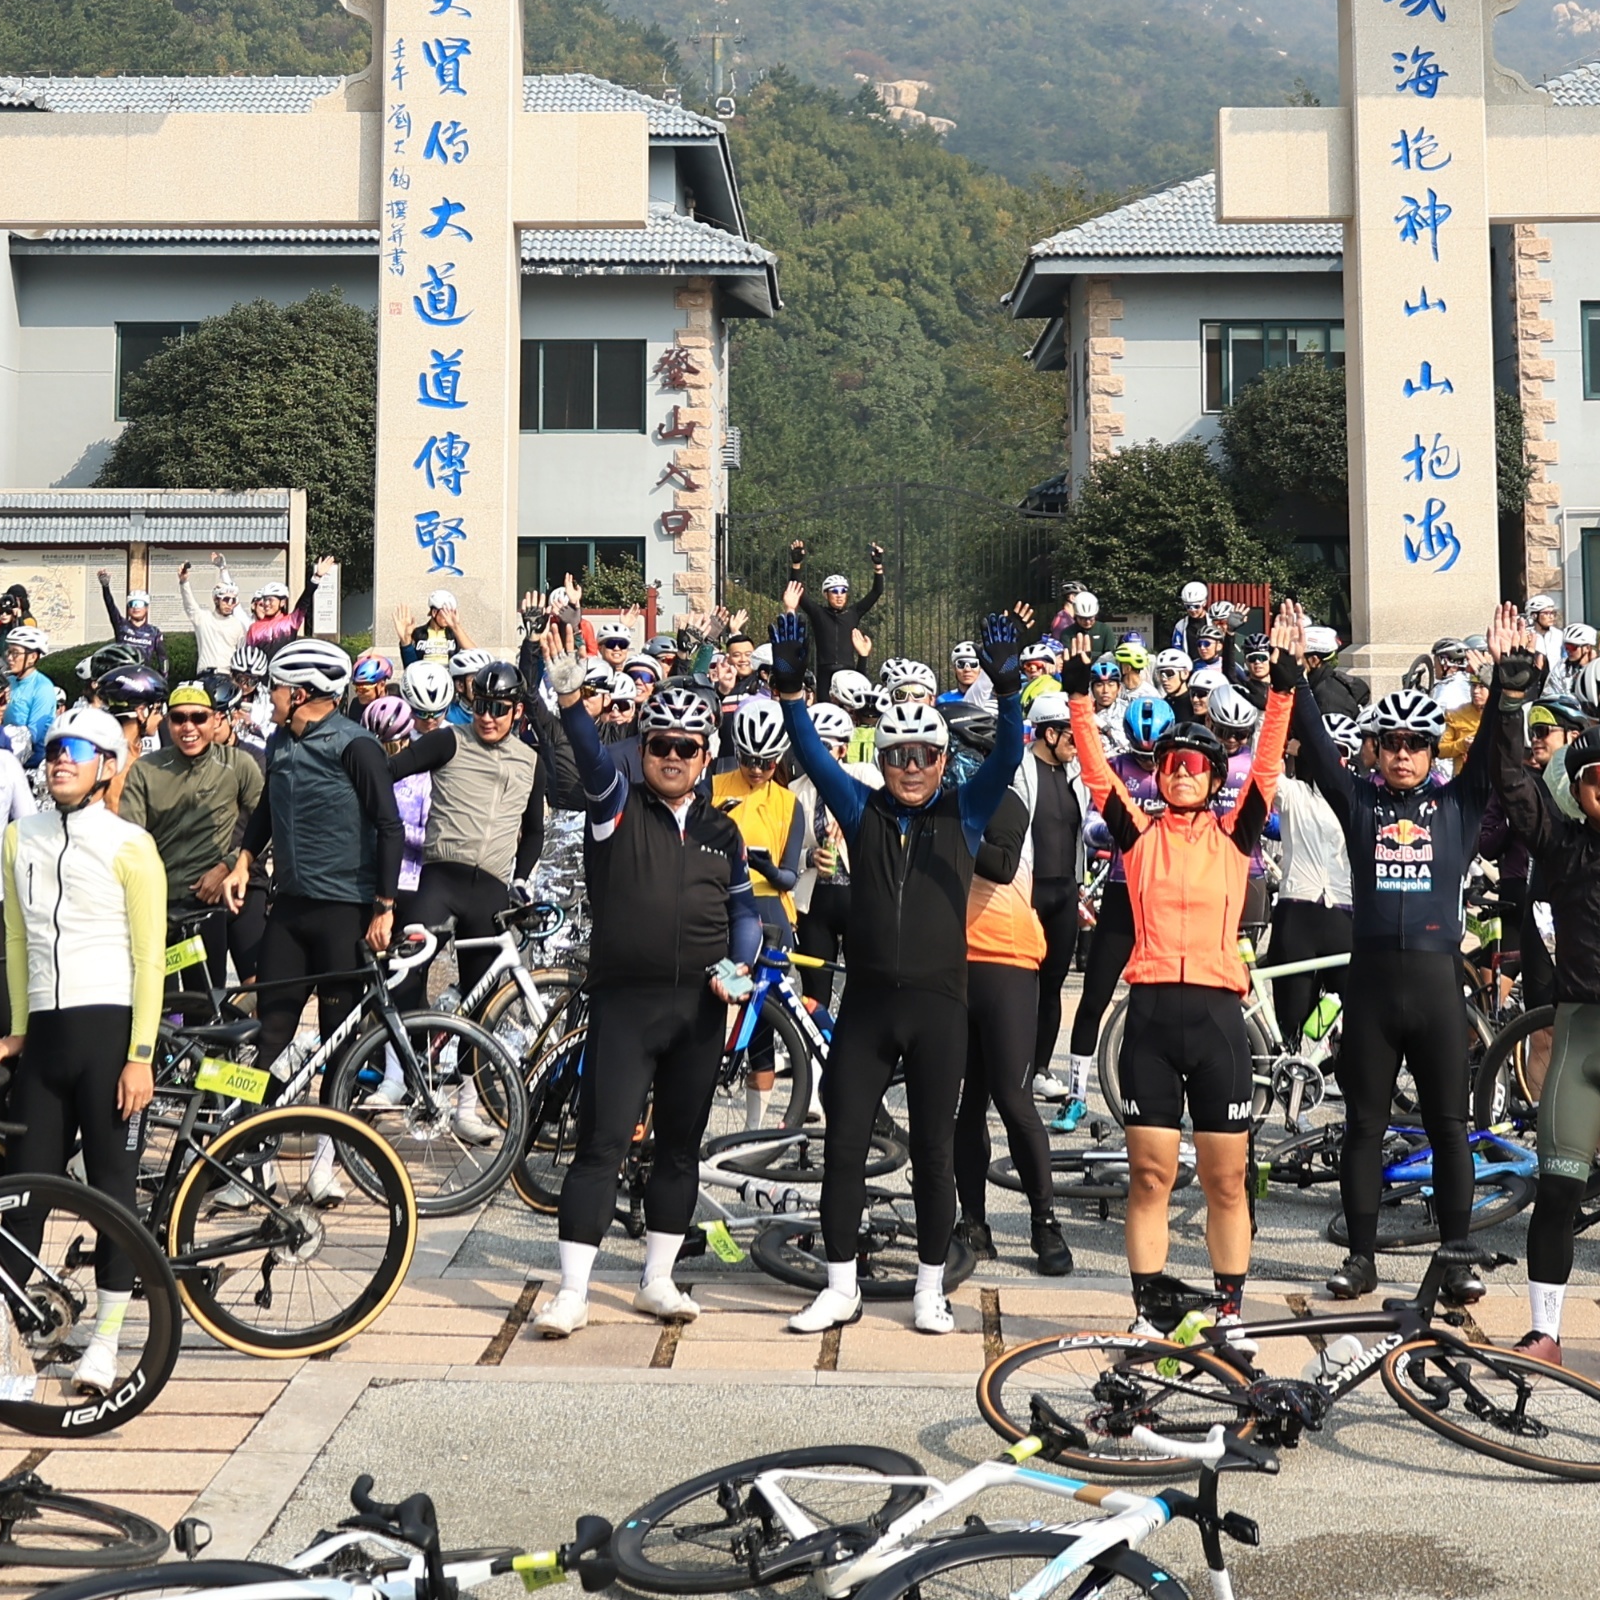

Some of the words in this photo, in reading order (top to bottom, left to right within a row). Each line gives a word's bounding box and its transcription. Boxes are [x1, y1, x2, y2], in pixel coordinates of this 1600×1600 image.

[653, 348, 712, 535] 登山入口
[1375, 863, 1432, 878] BORA
[225, 1074, 258, 1094] A002
[275, 1000, 363, 1107] MERIDA
[1058, 1335, 1151, 1349] roval
[1321, 1333, 1404, 1394] S-WORKS
[61, 1368, 146, 1430] roval
